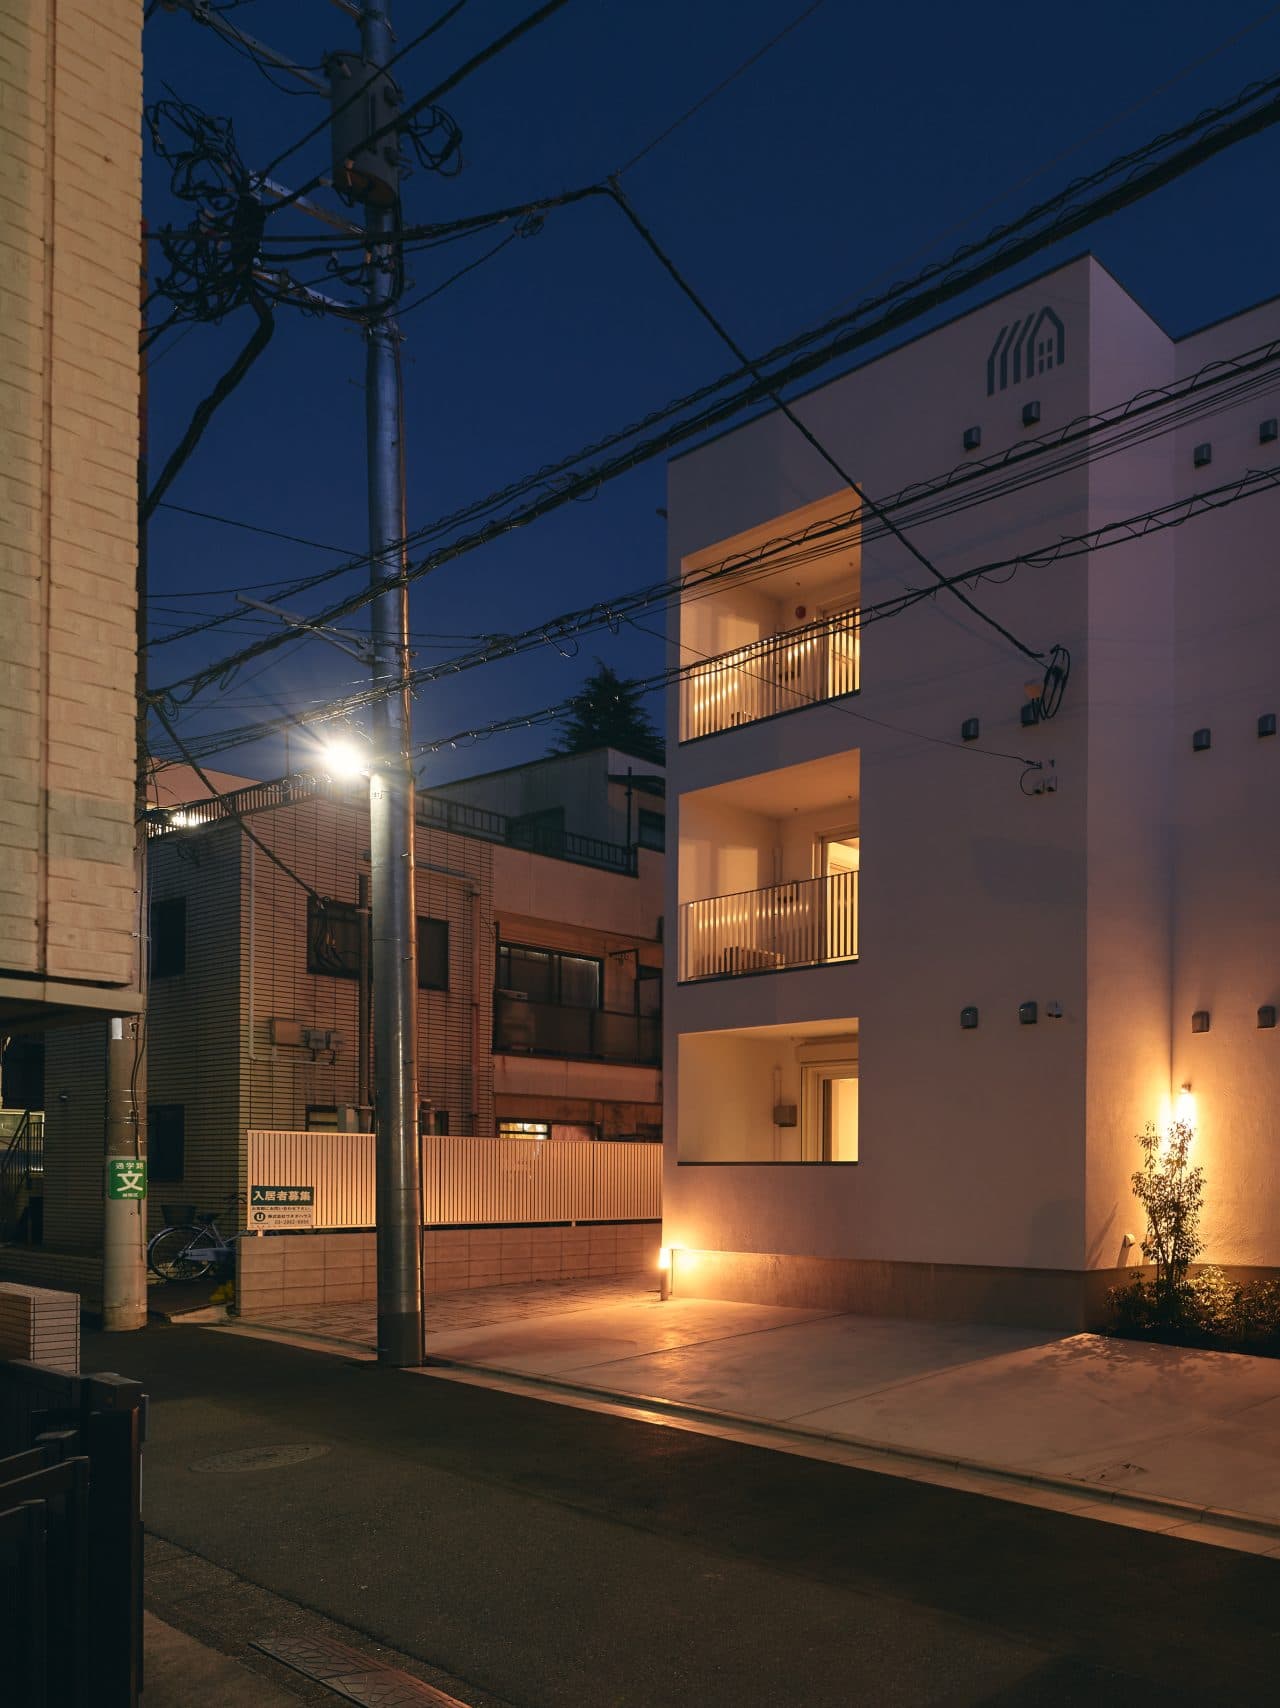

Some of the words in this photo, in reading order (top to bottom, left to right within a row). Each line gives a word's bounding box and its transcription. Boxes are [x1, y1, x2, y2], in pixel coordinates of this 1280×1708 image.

[115, 1162, 144, 1170] 通学路
[117, 1170, 143, 1192] 文
[253, 1190, 311, 1201] 入居者募集
